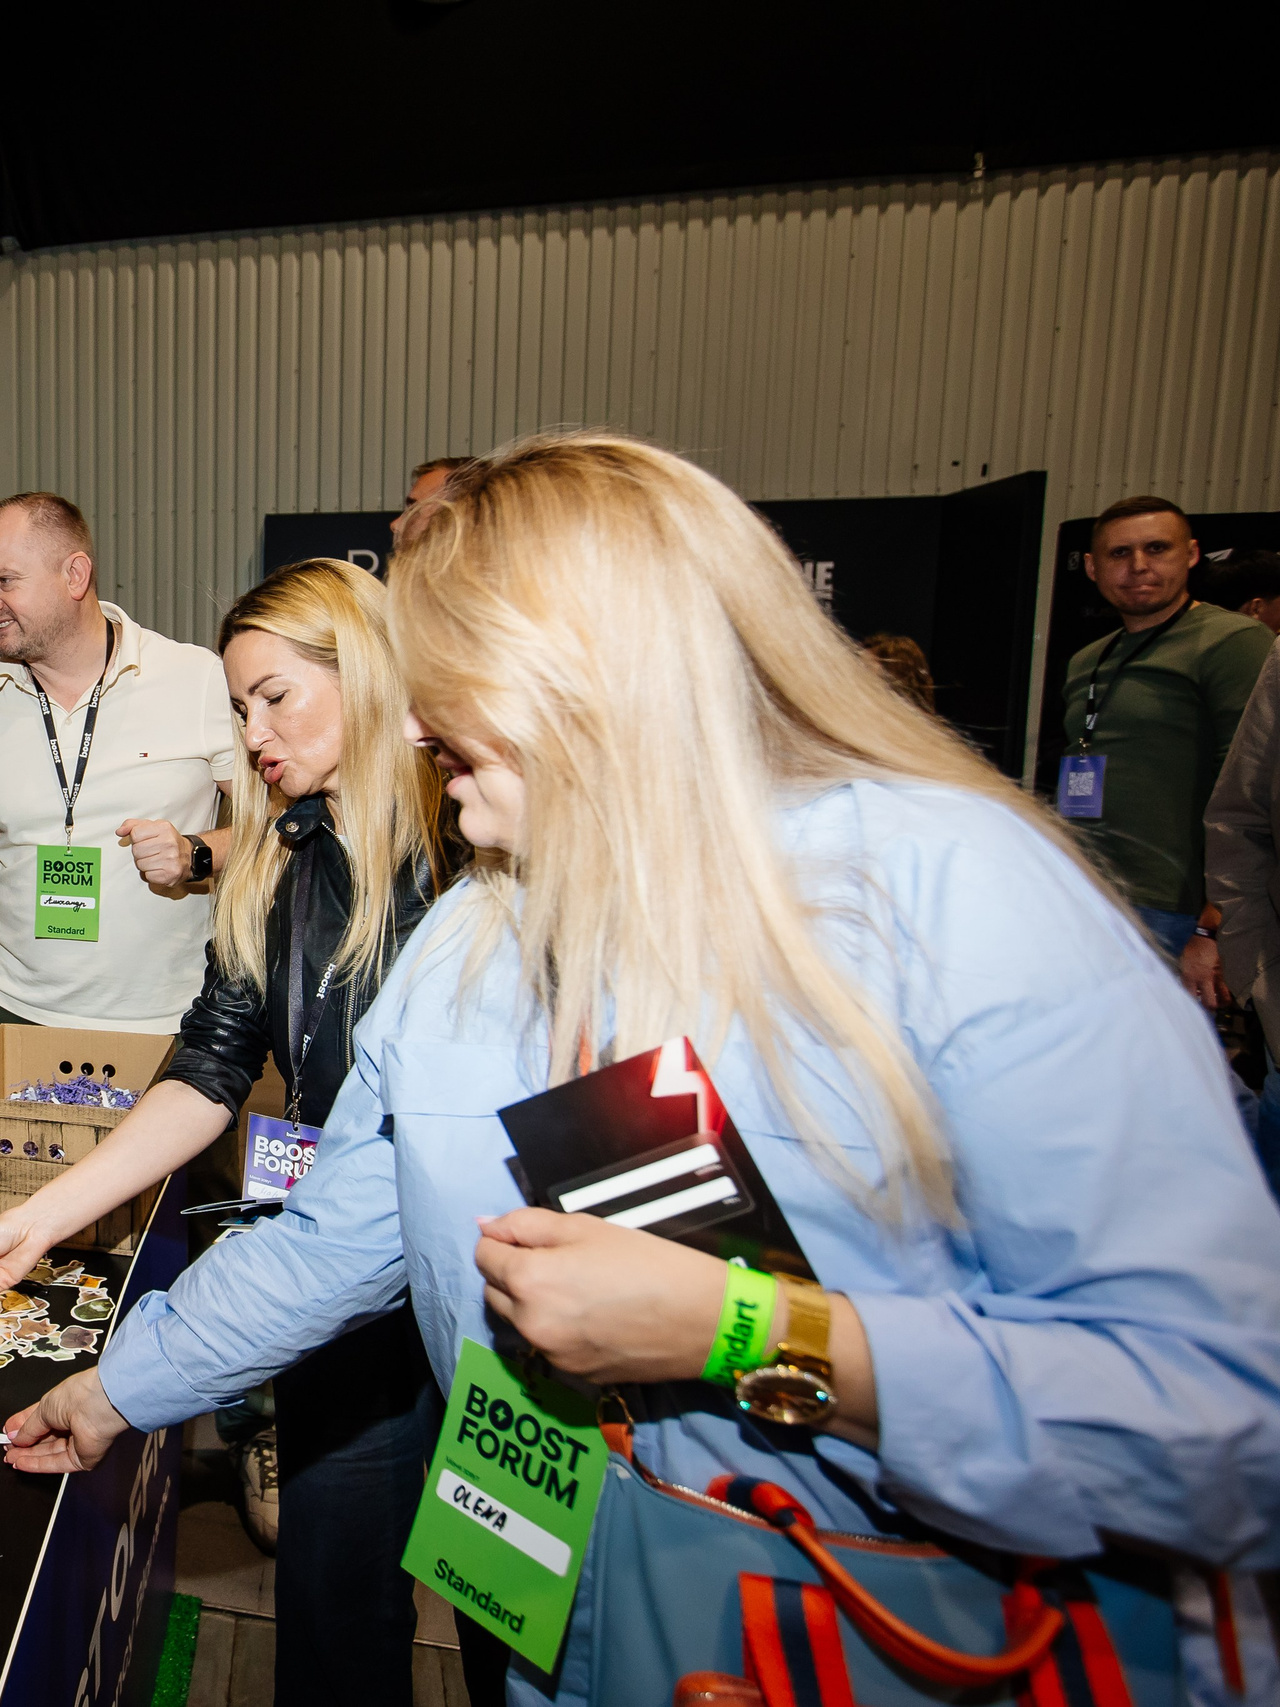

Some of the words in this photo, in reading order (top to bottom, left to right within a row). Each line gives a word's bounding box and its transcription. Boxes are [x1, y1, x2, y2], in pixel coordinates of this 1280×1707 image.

[39, 692, 50, 715] boost
[89, 684, 101, 708] boost
[49, 739, 61, 764] boost
[79, 733, 92, 758] boost
[43, 860, 94, 873] BOOST
[43, 872, 93, 886] FORUM
[47, 925, 85, 935] Standard
[316, 963, 337, 1000] boost
[253, 1152, 312, 1180] FORU
[464, 1383, 590, 1474] BOOST
[457, 1415, 580, 1510] FORUM
[434, 1558, 525, 1635] Standard
